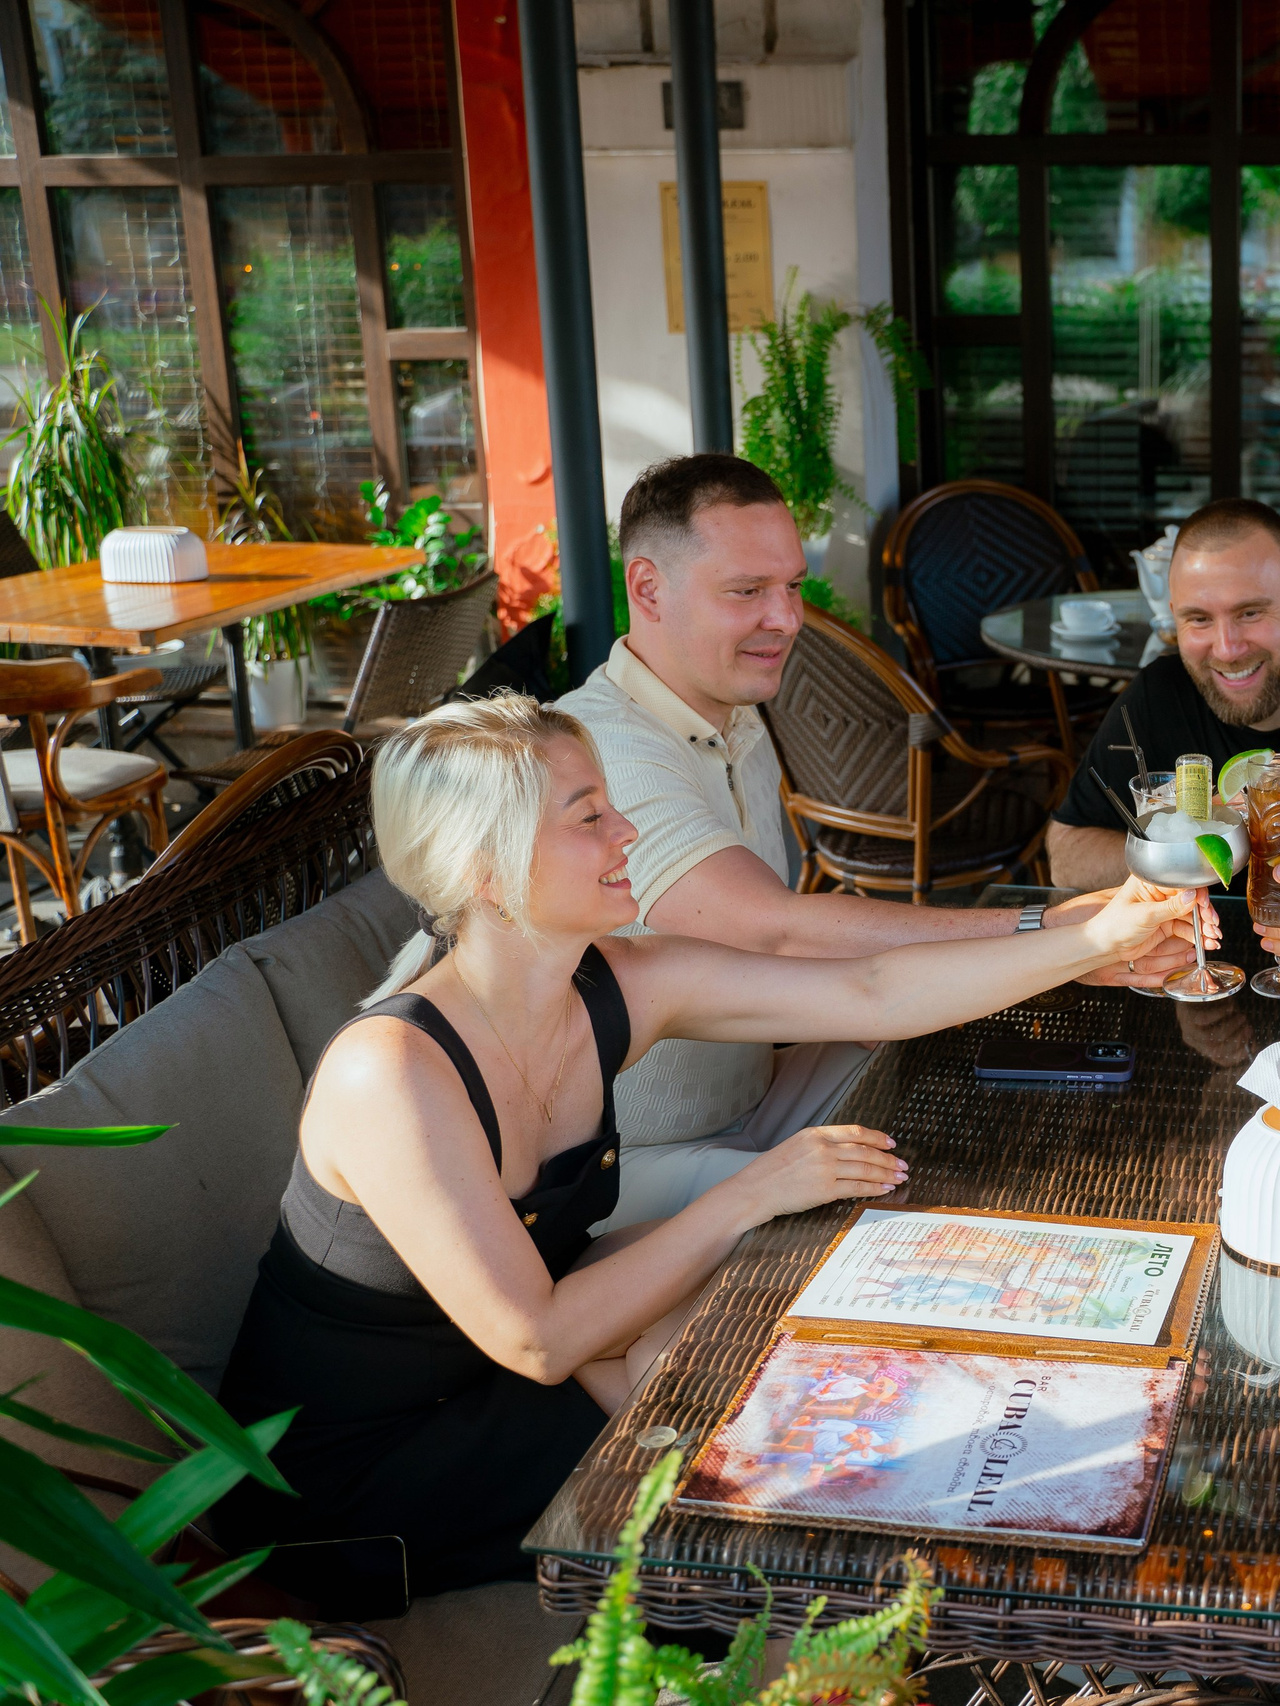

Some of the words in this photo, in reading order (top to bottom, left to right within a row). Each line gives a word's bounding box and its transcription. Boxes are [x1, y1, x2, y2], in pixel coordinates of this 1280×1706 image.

[1145, 1243, 1174, 1277] ЛЕТО
[1140, 1290, 1154, 1307] CUBA
[1129, 1315, 1144, 1333] LEAL
[1037, 1376, 1052, 1392] BAR
[997, 1379, 1037, 1432] CUBA
[967, 1458, 1009, 1512] LEAL
